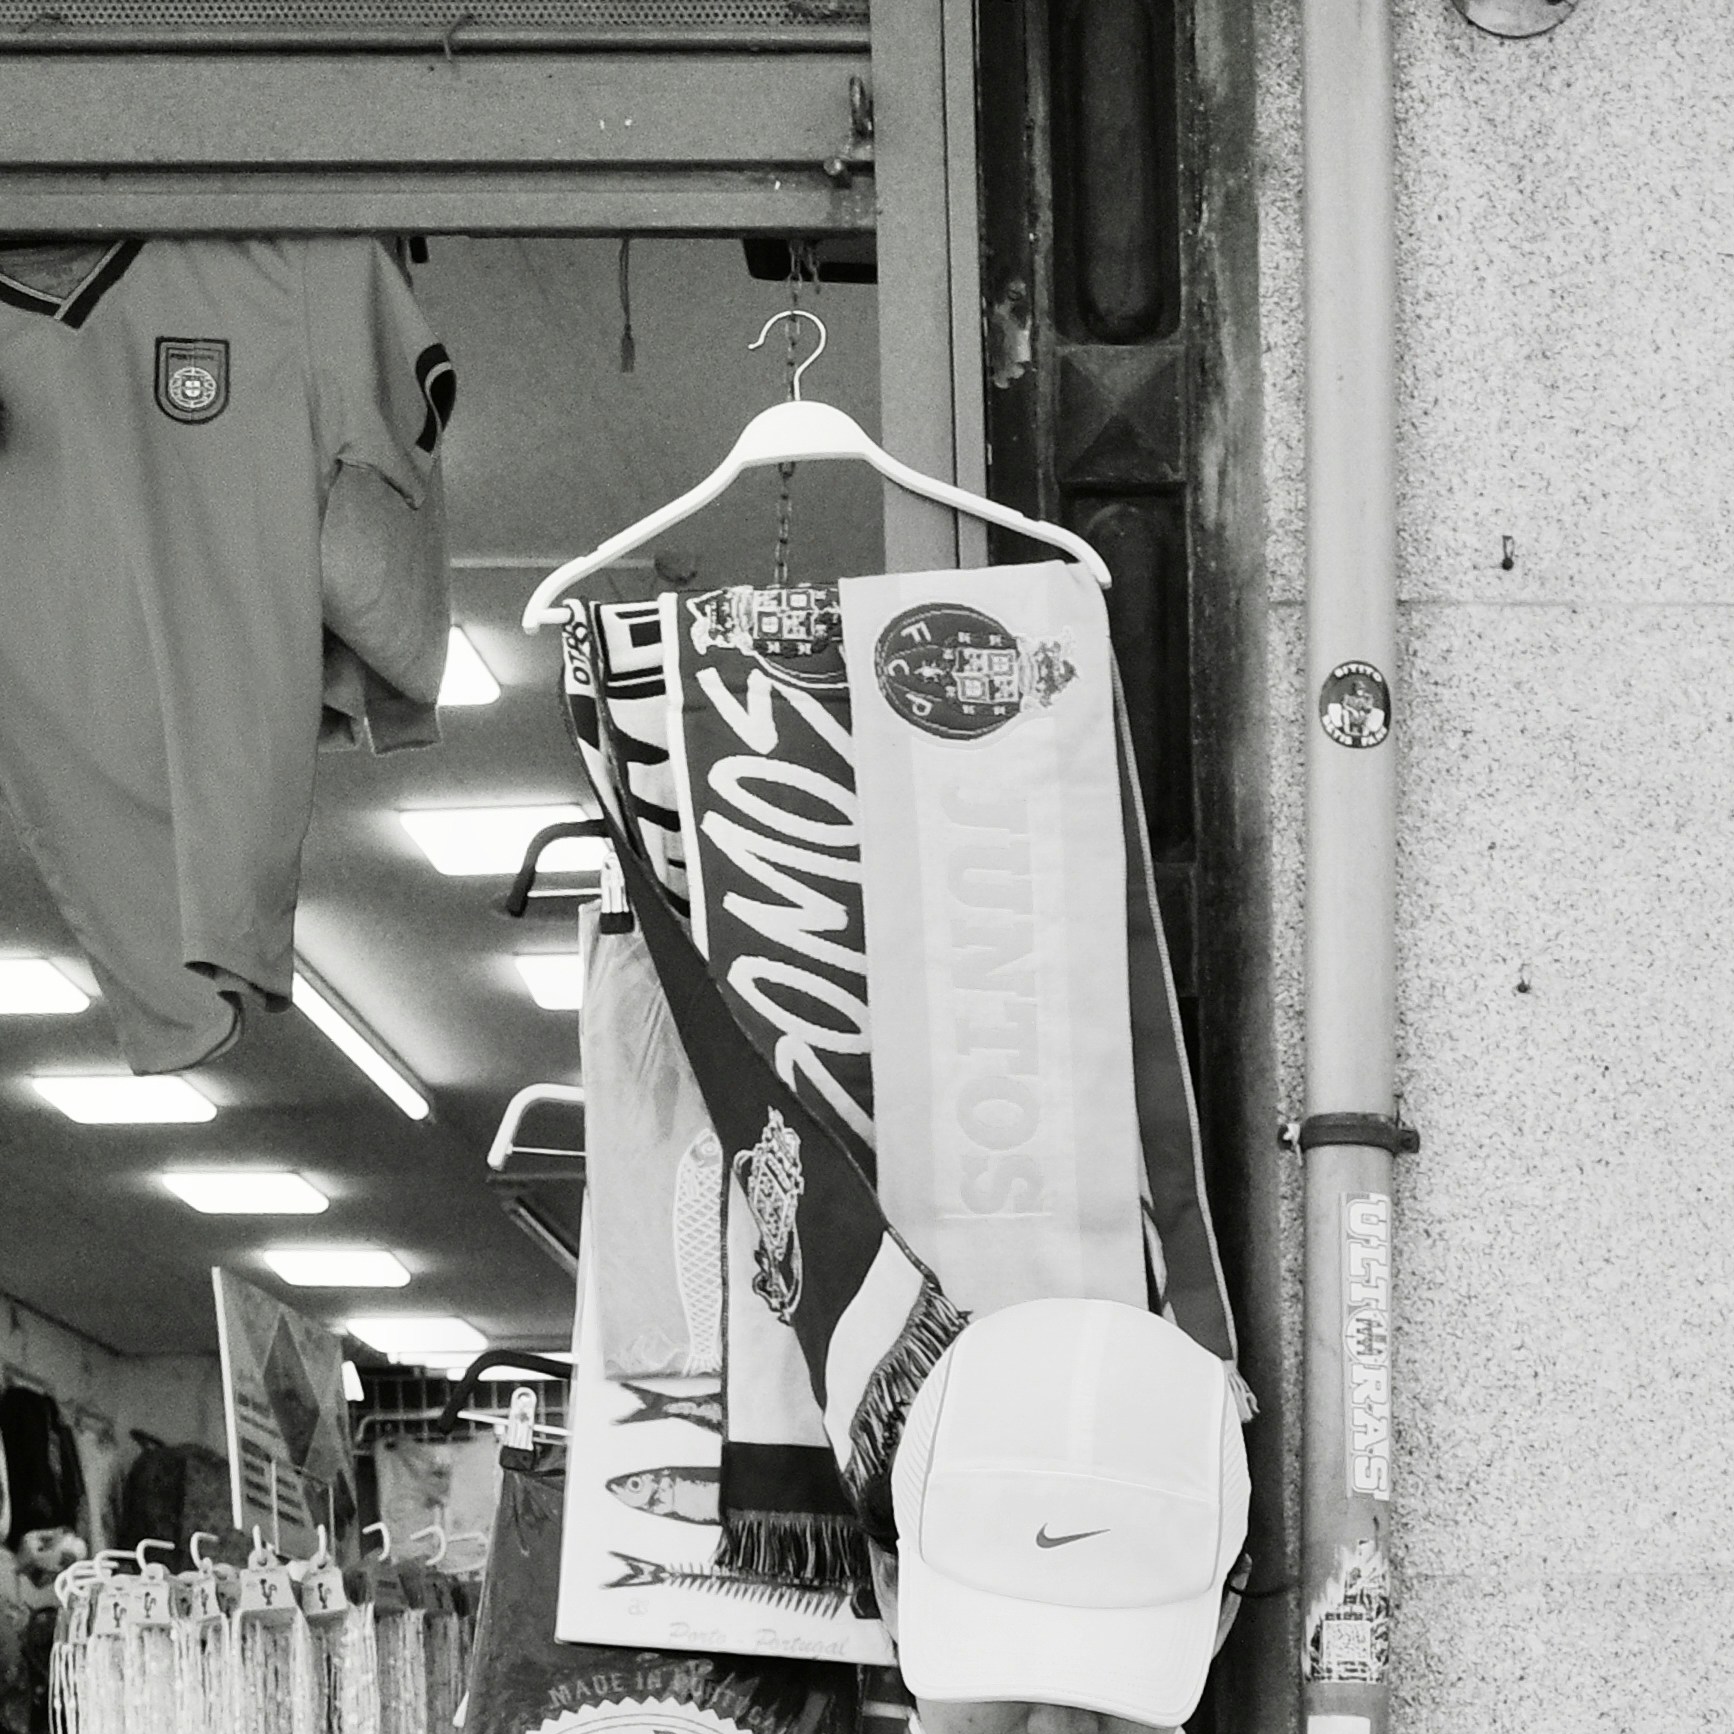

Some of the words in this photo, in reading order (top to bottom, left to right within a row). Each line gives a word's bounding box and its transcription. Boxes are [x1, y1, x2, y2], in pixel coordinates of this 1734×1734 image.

[940, 783, 1045, 1216] JUNTOS
[669, 1622, 727, 1647] Porto
[757, 1628, 849, 1656] Portugal
[548, 1673, 626, 1710] MADE
[637, 1668, 662, 1691] IN
